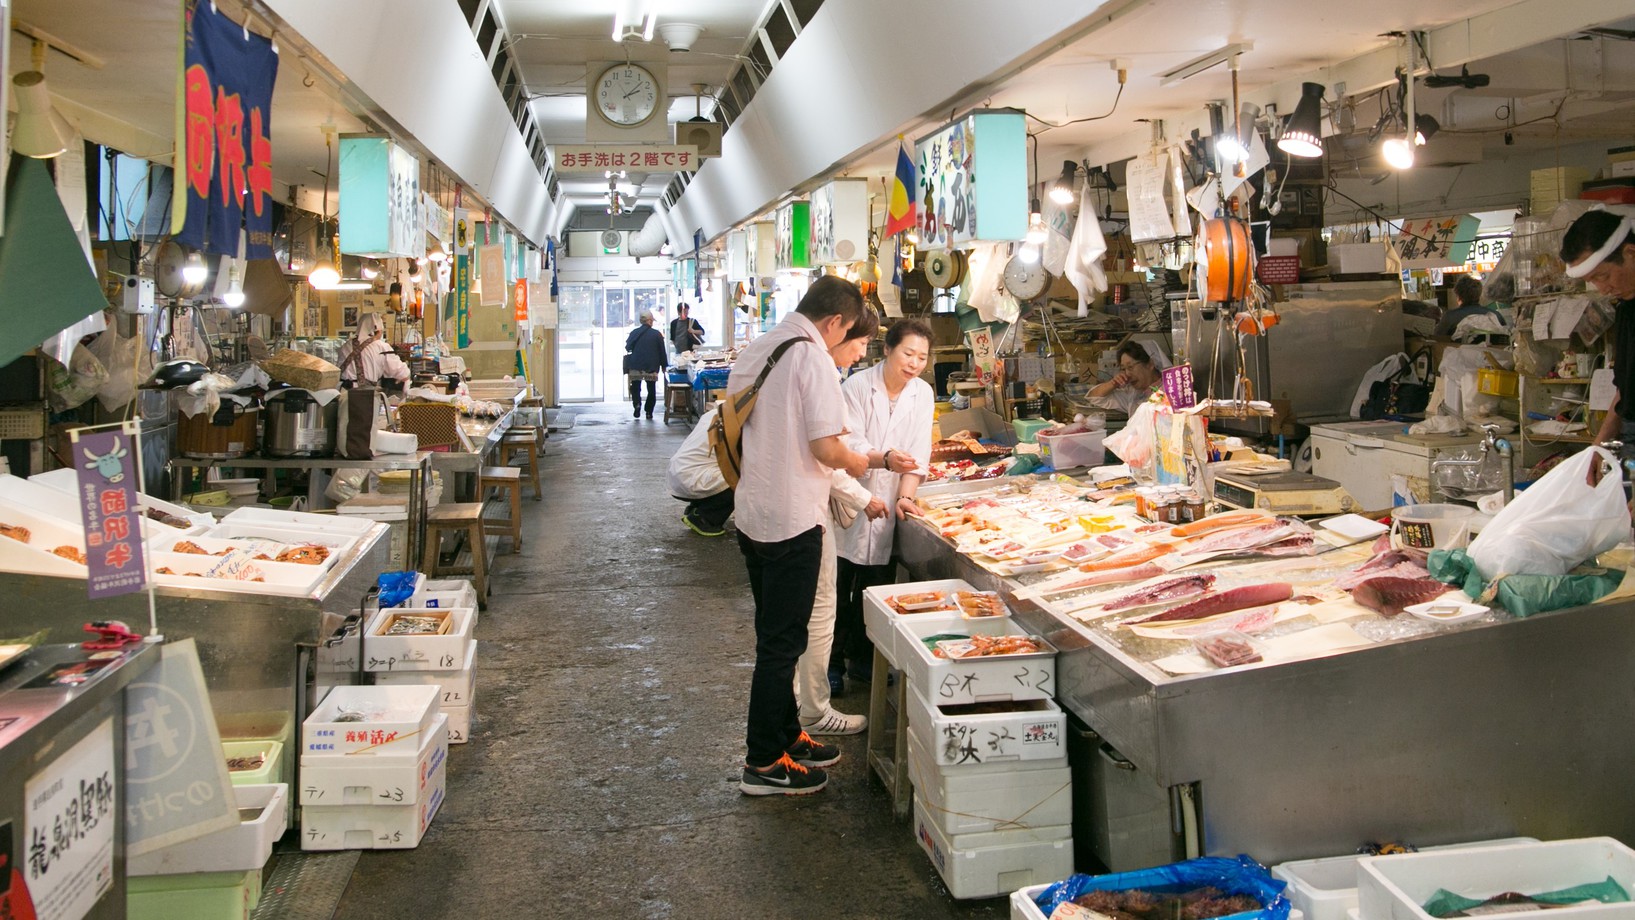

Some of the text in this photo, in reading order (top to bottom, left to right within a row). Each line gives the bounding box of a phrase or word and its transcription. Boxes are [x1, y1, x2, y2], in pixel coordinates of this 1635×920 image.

[612, 72, 619, 80] 11
[624, 70, 633, 78] 12
[637, 73, 641, 81] 1
[604, 80, 612, 88] 10
[645, 81, 651, 90] 2
[601, 90, 607, 98] 9
[647, 92, 653, 101] 3
